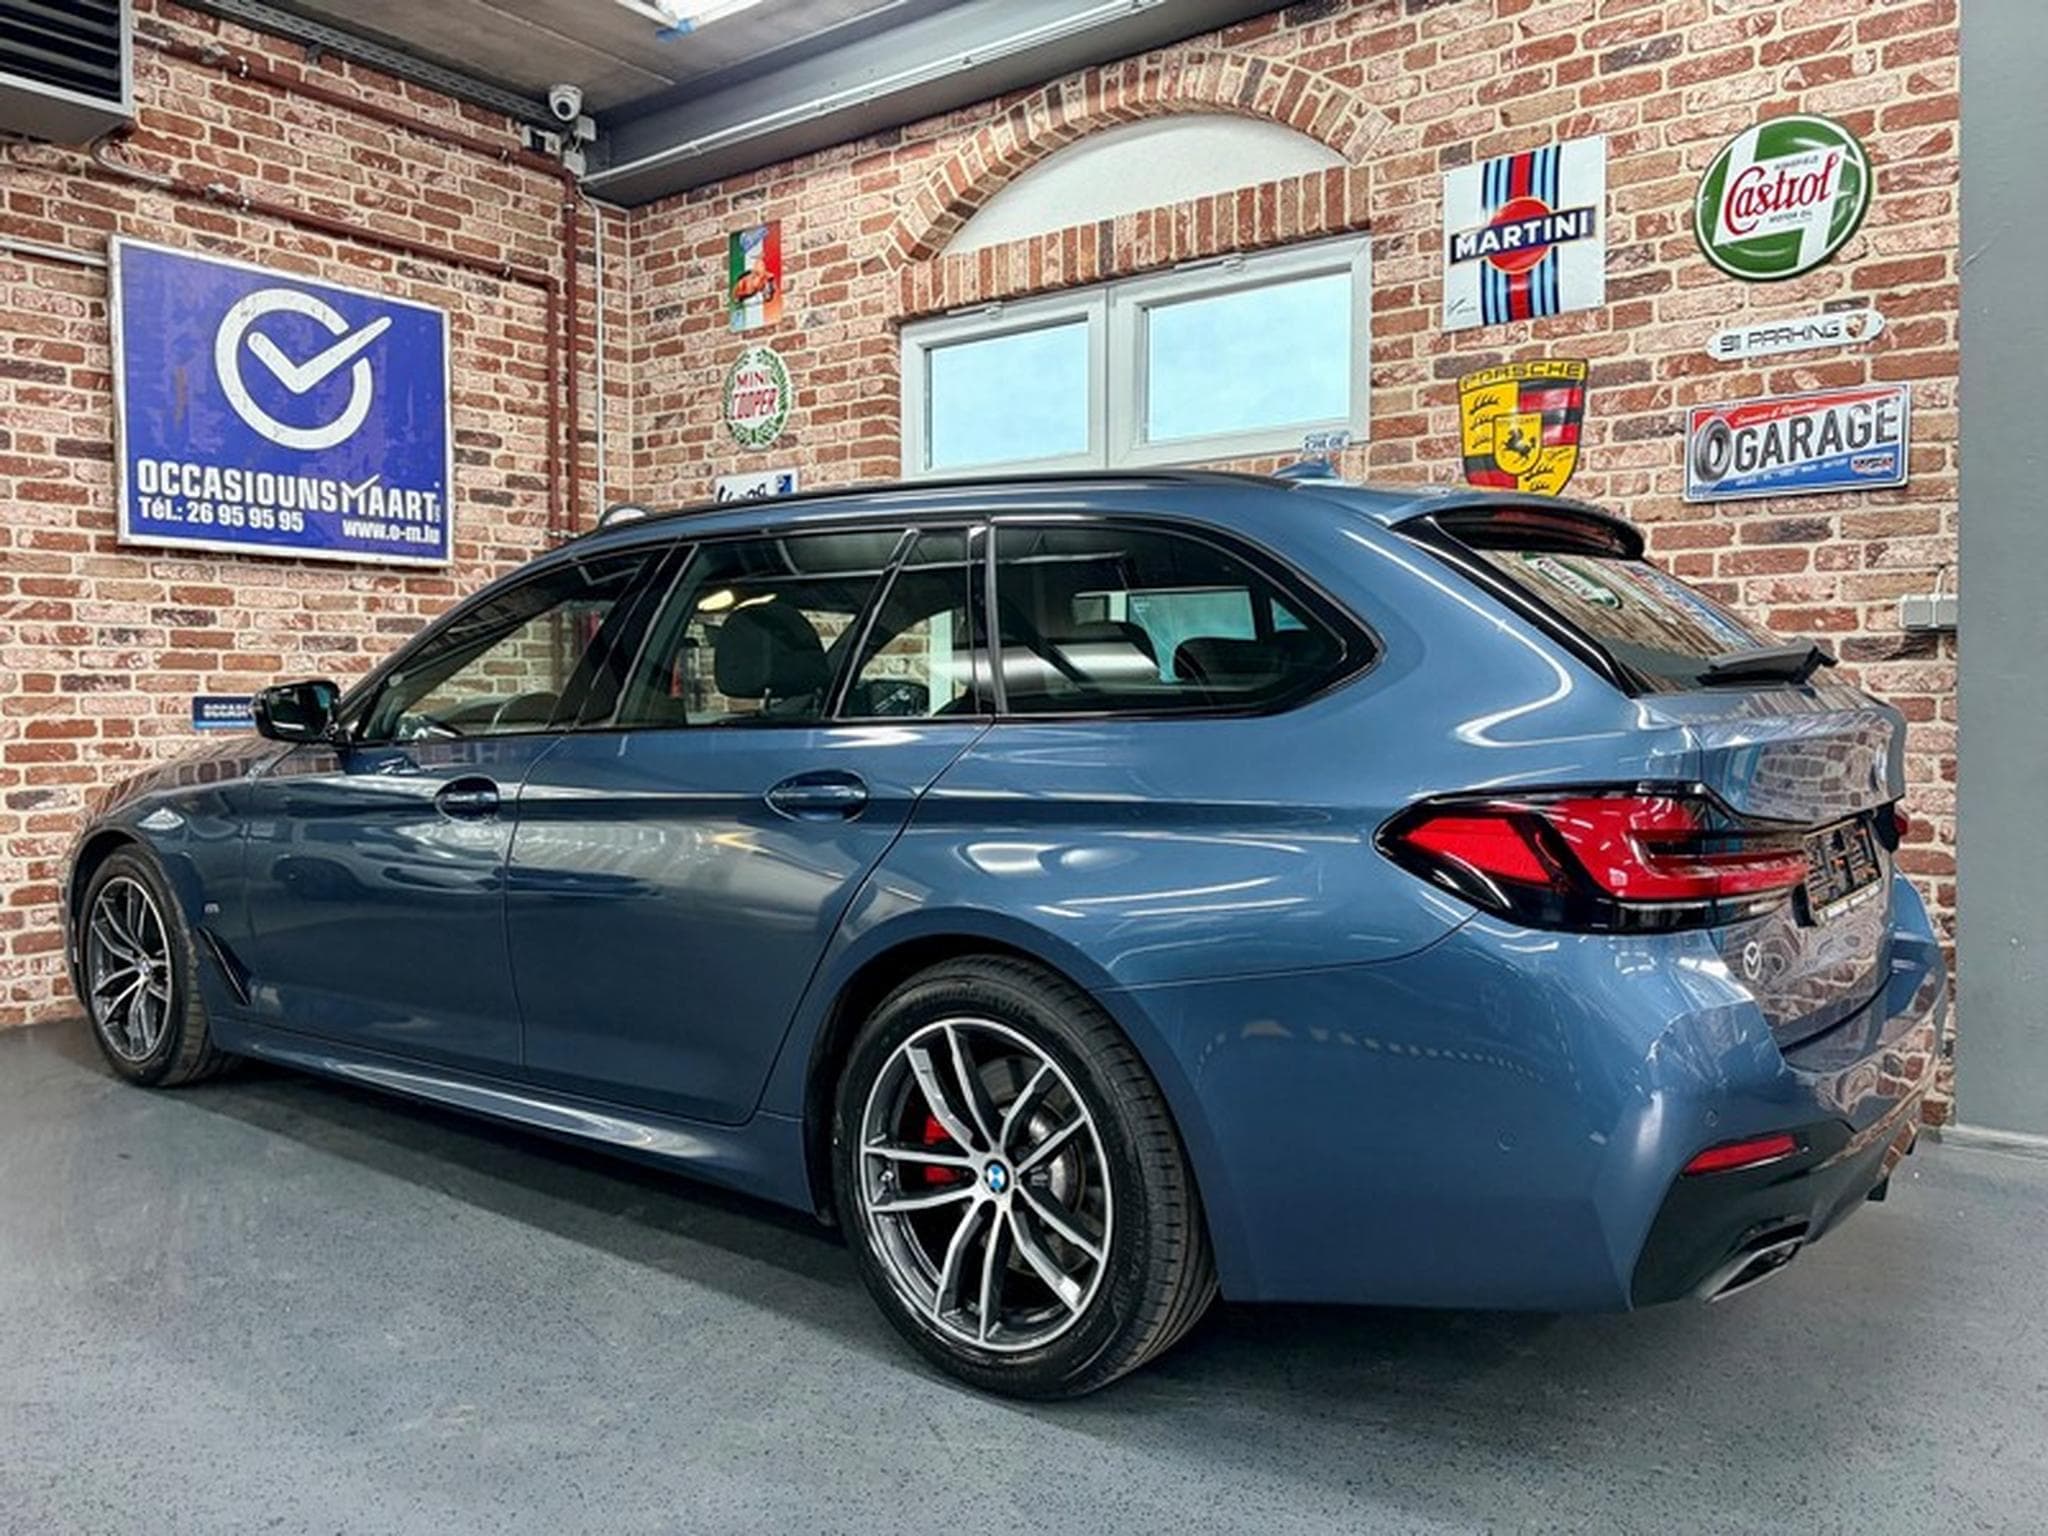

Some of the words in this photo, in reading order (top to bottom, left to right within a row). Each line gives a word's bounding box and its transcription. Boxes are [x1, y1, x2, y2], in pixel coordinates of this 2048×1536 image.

[1725, 152, 1839, 236] Castrol
[1455, 211, 1588, 259] MARTINI
[1748, 320, 1841, 346] PARKING
[1463, 363, 1580, 388] PORSCHE
[1734, 396, 1900, 472] GARAGE
[187, 501, 214, 524] 26
[218, 505, 246, 527] 95
[250, 508, 275, 529] 95
[278, 510, 304, 532] 95
[342, 519, 440, 544] www.o-m.lu
